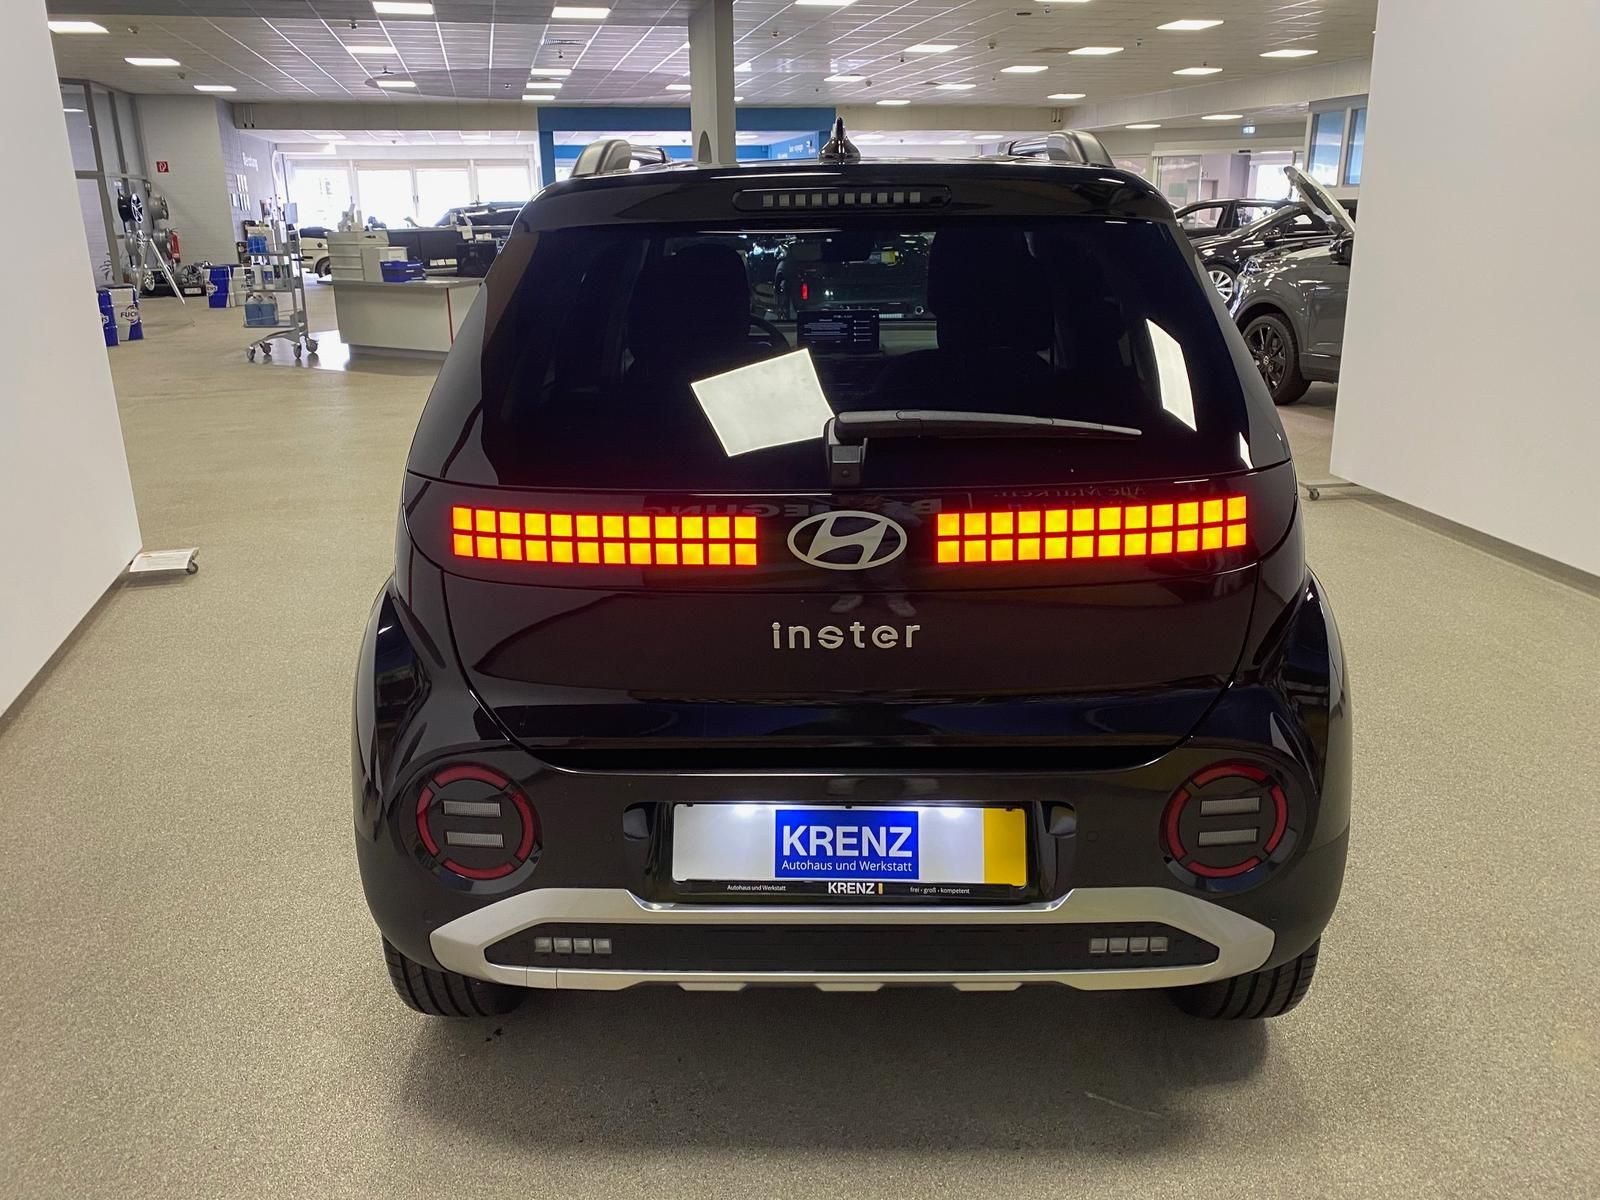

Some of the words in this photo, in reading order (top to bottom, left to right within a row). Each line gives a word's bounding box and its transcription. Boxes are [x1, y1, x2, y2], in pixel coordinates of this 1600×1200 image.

[772, 622, 921, 649] inster
[783, 825, 913, 857] KRENZ
[781, 860, 833, 870] Autohaus
[835, 861, 856, 871] und
[860, 861, 912, 872] Werkstatt
[828, 882, 875, 894] KRENZ
